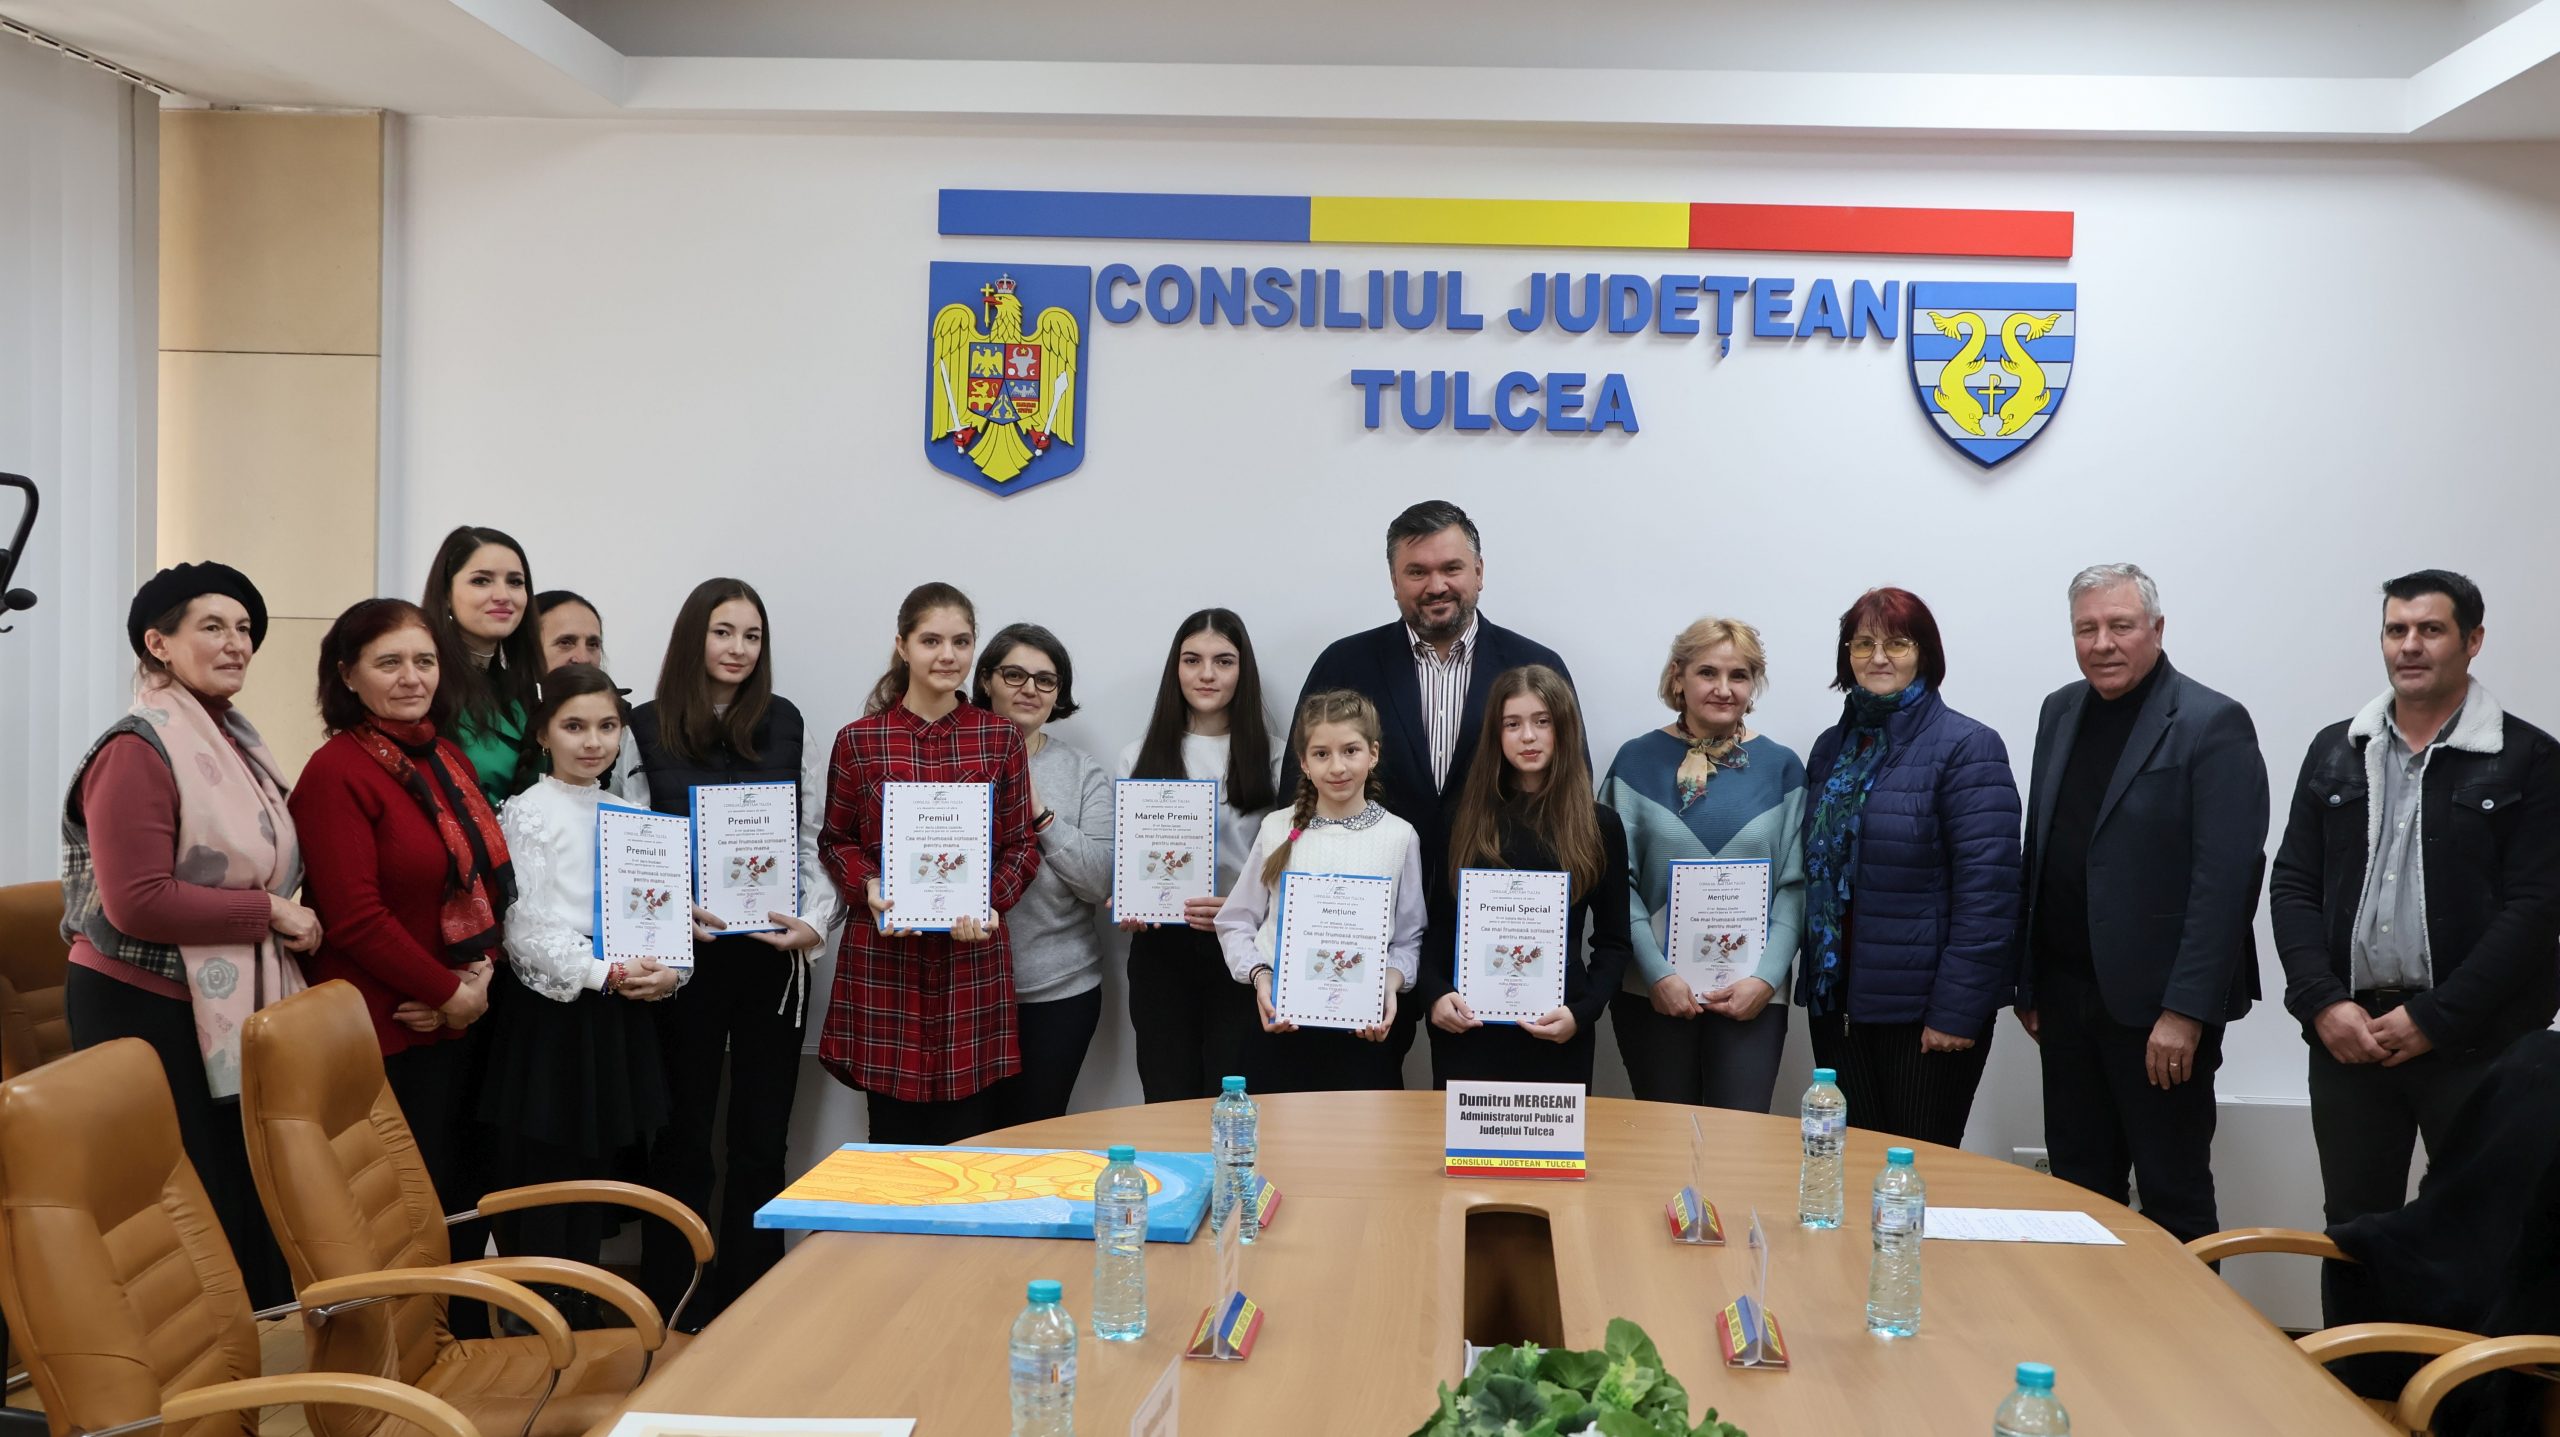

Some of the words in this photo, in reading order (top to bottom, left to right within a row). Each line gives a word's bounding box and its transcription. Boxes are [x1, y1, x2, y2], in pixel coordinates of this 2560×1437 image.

[1096, 264, 1484, 331] CONSILIUL
[1508, 272, 1900, 358] JUDEȚEAN
[1351, 369, 1640, 432] TULCEA
[728, 817, 761, 825] Premiul
[764, 816, 770, 824] II
[918, 813, 953, 822] Premiul
[1135, 812, 1165, 820] Marele
[1167, 813, 1198, 821] Premiu
[626, 845, 656, 856] Premiul
[1480, 903, 1515, 912] Premiul
[1518, 904, 1551, 915] Special
[1459, 1093, 1511, 1107] Dumitru
[1513, 1094, 1576, 1109] MERGEANI
[1460, 1111, 1533, 1122] Administratorul
[1534, 1112, 1563, 1123] Public
[1565, 1113, 1574, 1123] al
[1479, 1125, 1522, 1138] Județului
[1523, 1126, 1555, 1137] Tulcea
[1451, 1158, 1494, 1166] CONSILIUL
[1498, 1159, 1541, 1167] JUDETEAN
[1545, 1160, 1577, 1168] TULCEA
